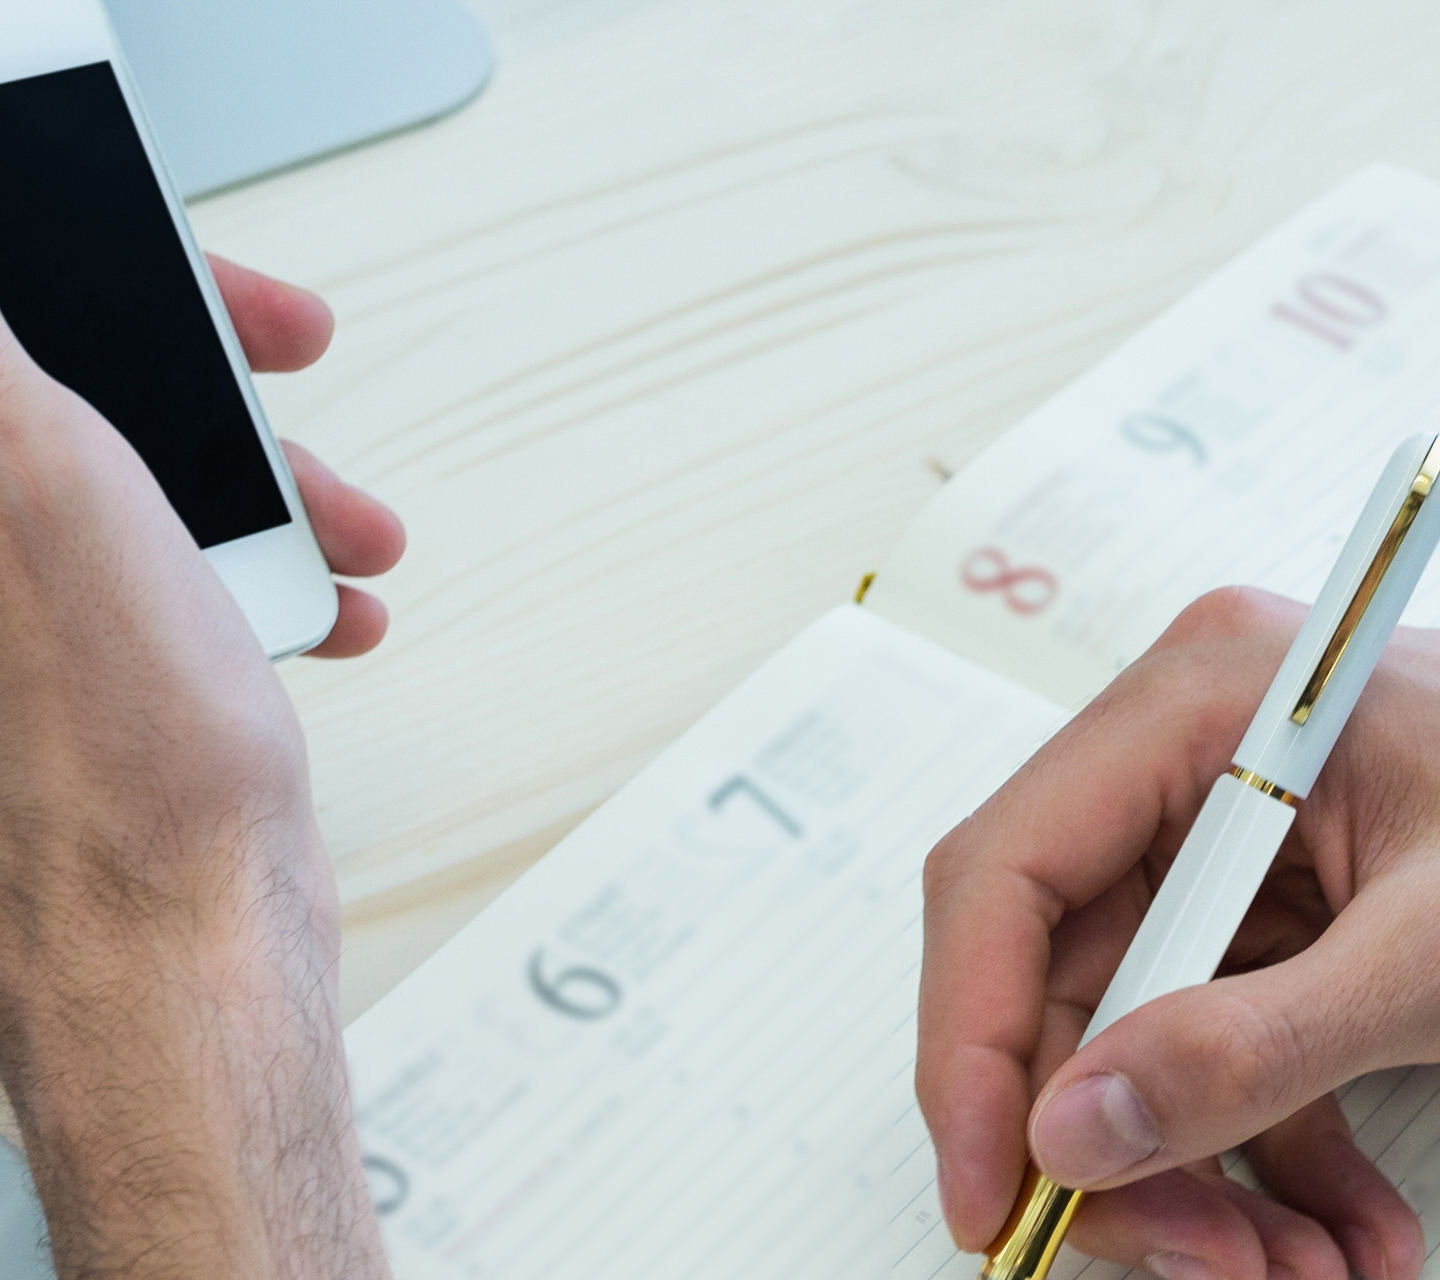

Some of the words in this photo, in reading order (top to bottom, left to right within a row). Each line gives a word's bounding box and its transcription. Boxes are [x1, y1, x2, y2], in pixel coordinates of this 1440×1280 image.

[1271, 271, 1386, 352] 10
[1120, 412, 1208, 468] 9
[960, 544, 1060, 617] 8
[709, 773, 803, 838] 7
[528, 944, 622, 1022] 6
